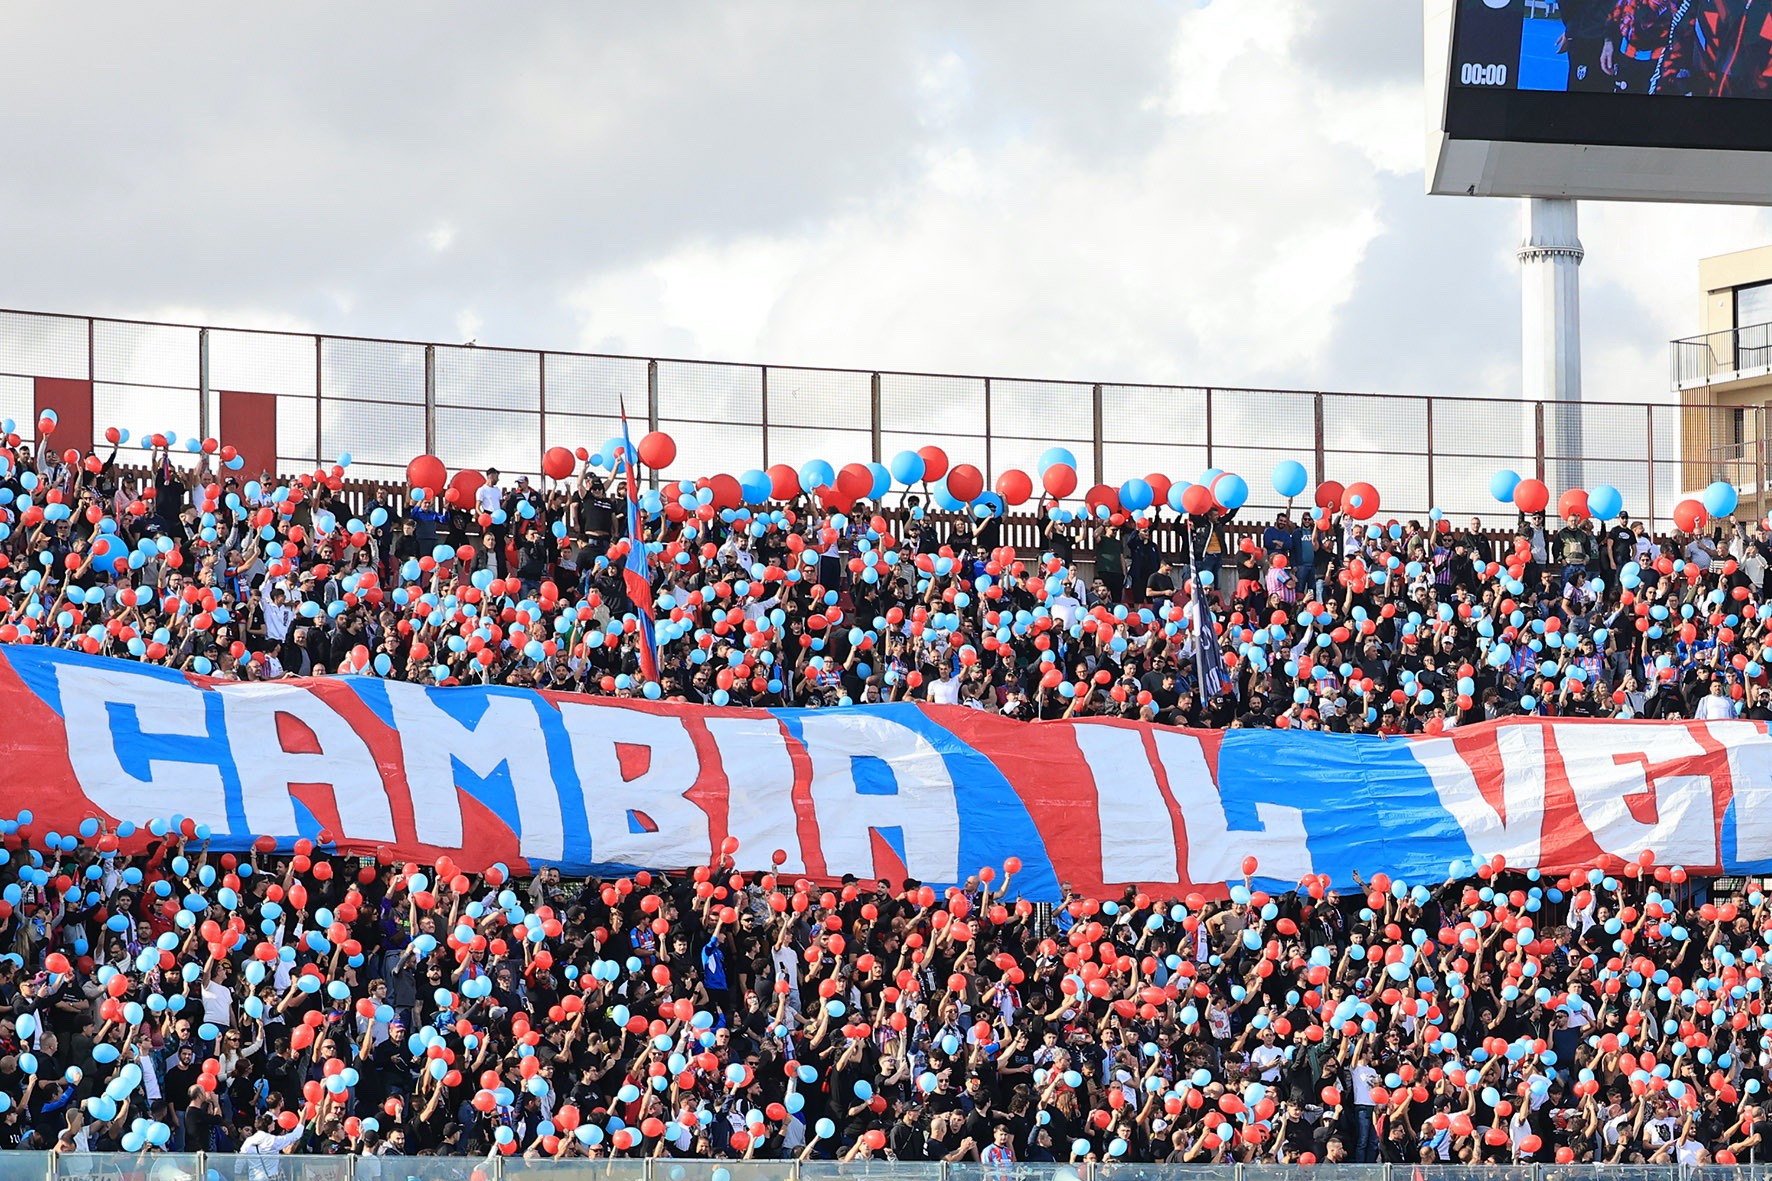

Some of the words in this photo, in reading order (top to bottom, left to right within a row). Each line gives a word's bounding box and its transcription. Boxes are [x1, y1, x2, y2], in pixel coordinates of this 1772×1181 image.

[1461, 63, 1507, 86] 00:00
[53, 662, 960, 886] CAMBIA
[1073, 722, 1312, 885] IL
